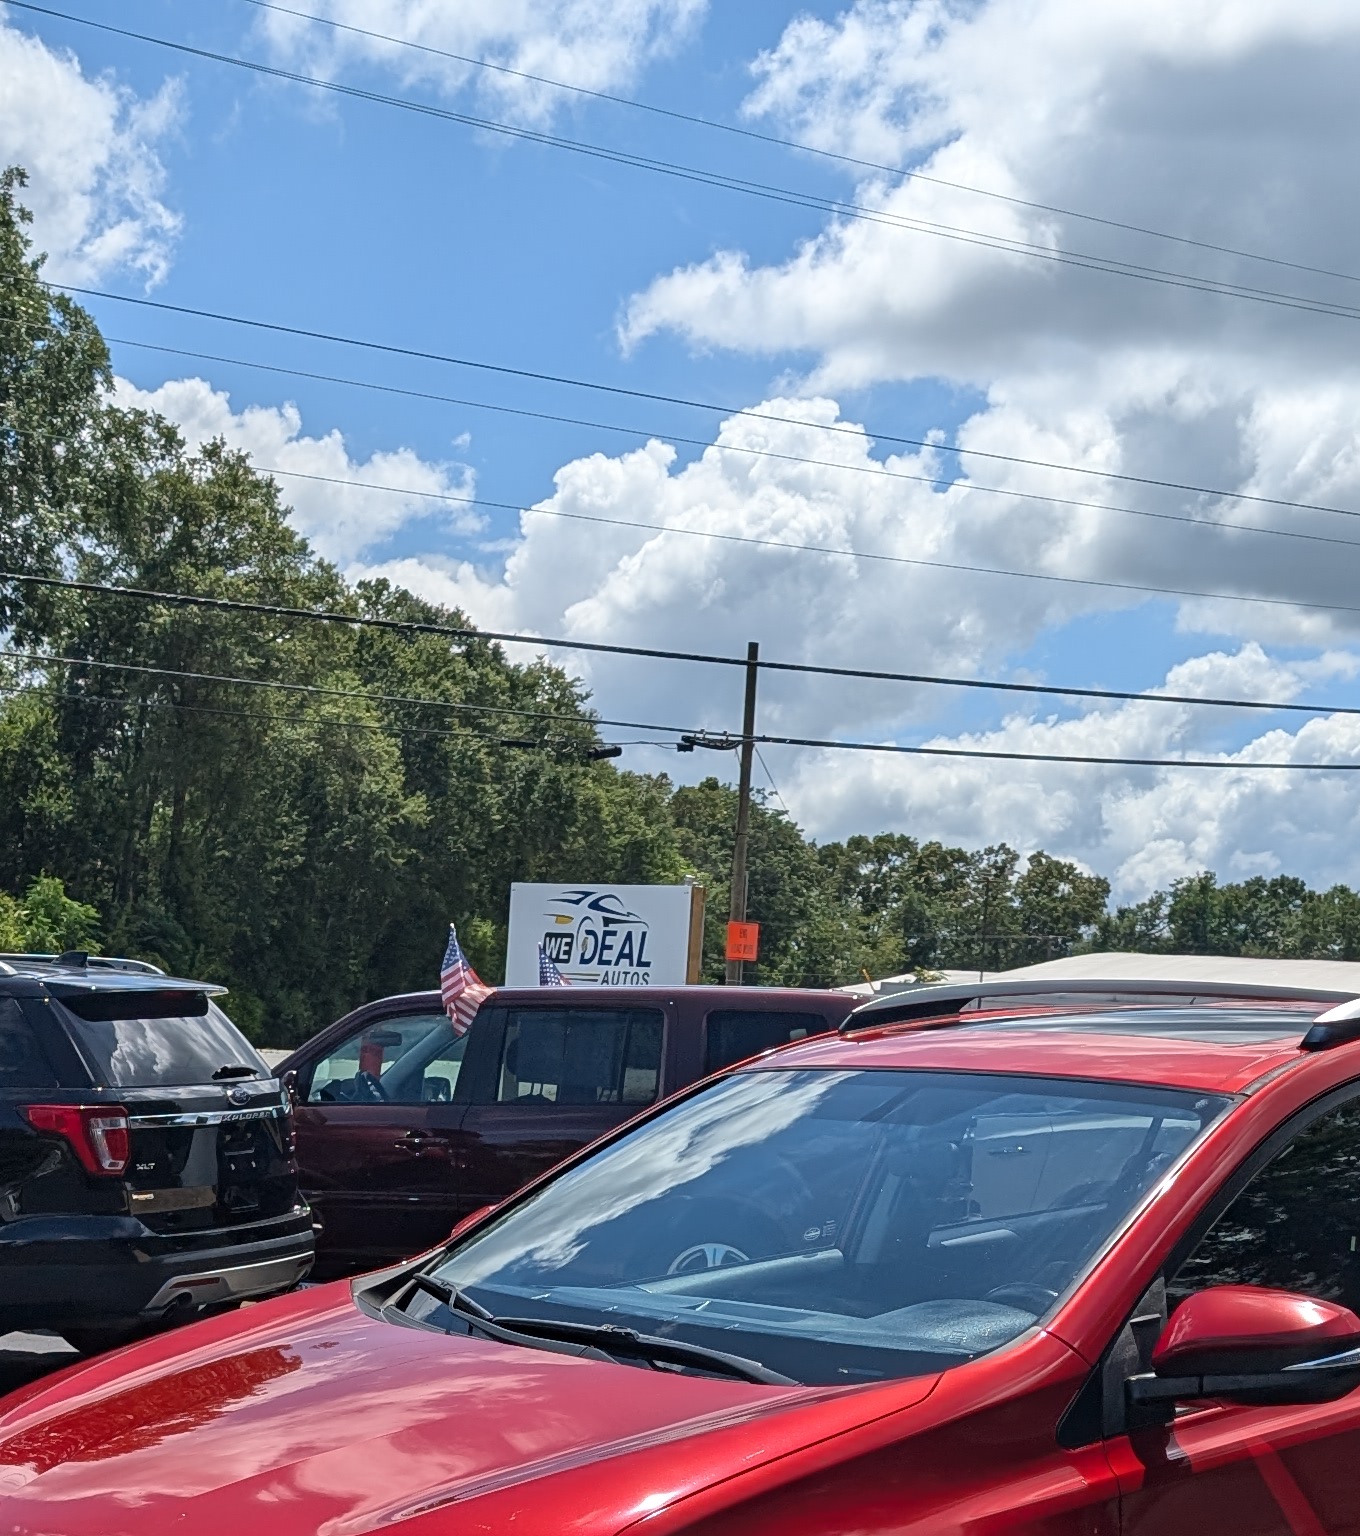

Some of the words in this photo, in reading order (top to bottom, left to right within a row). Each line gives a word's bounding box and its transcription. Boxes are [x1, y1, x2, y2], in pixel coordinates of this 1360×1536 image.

[545, 936, 572, 960] WE
[579, 929, 652, 968] DEAL
[600, 970, 651, 985] AUTOS
